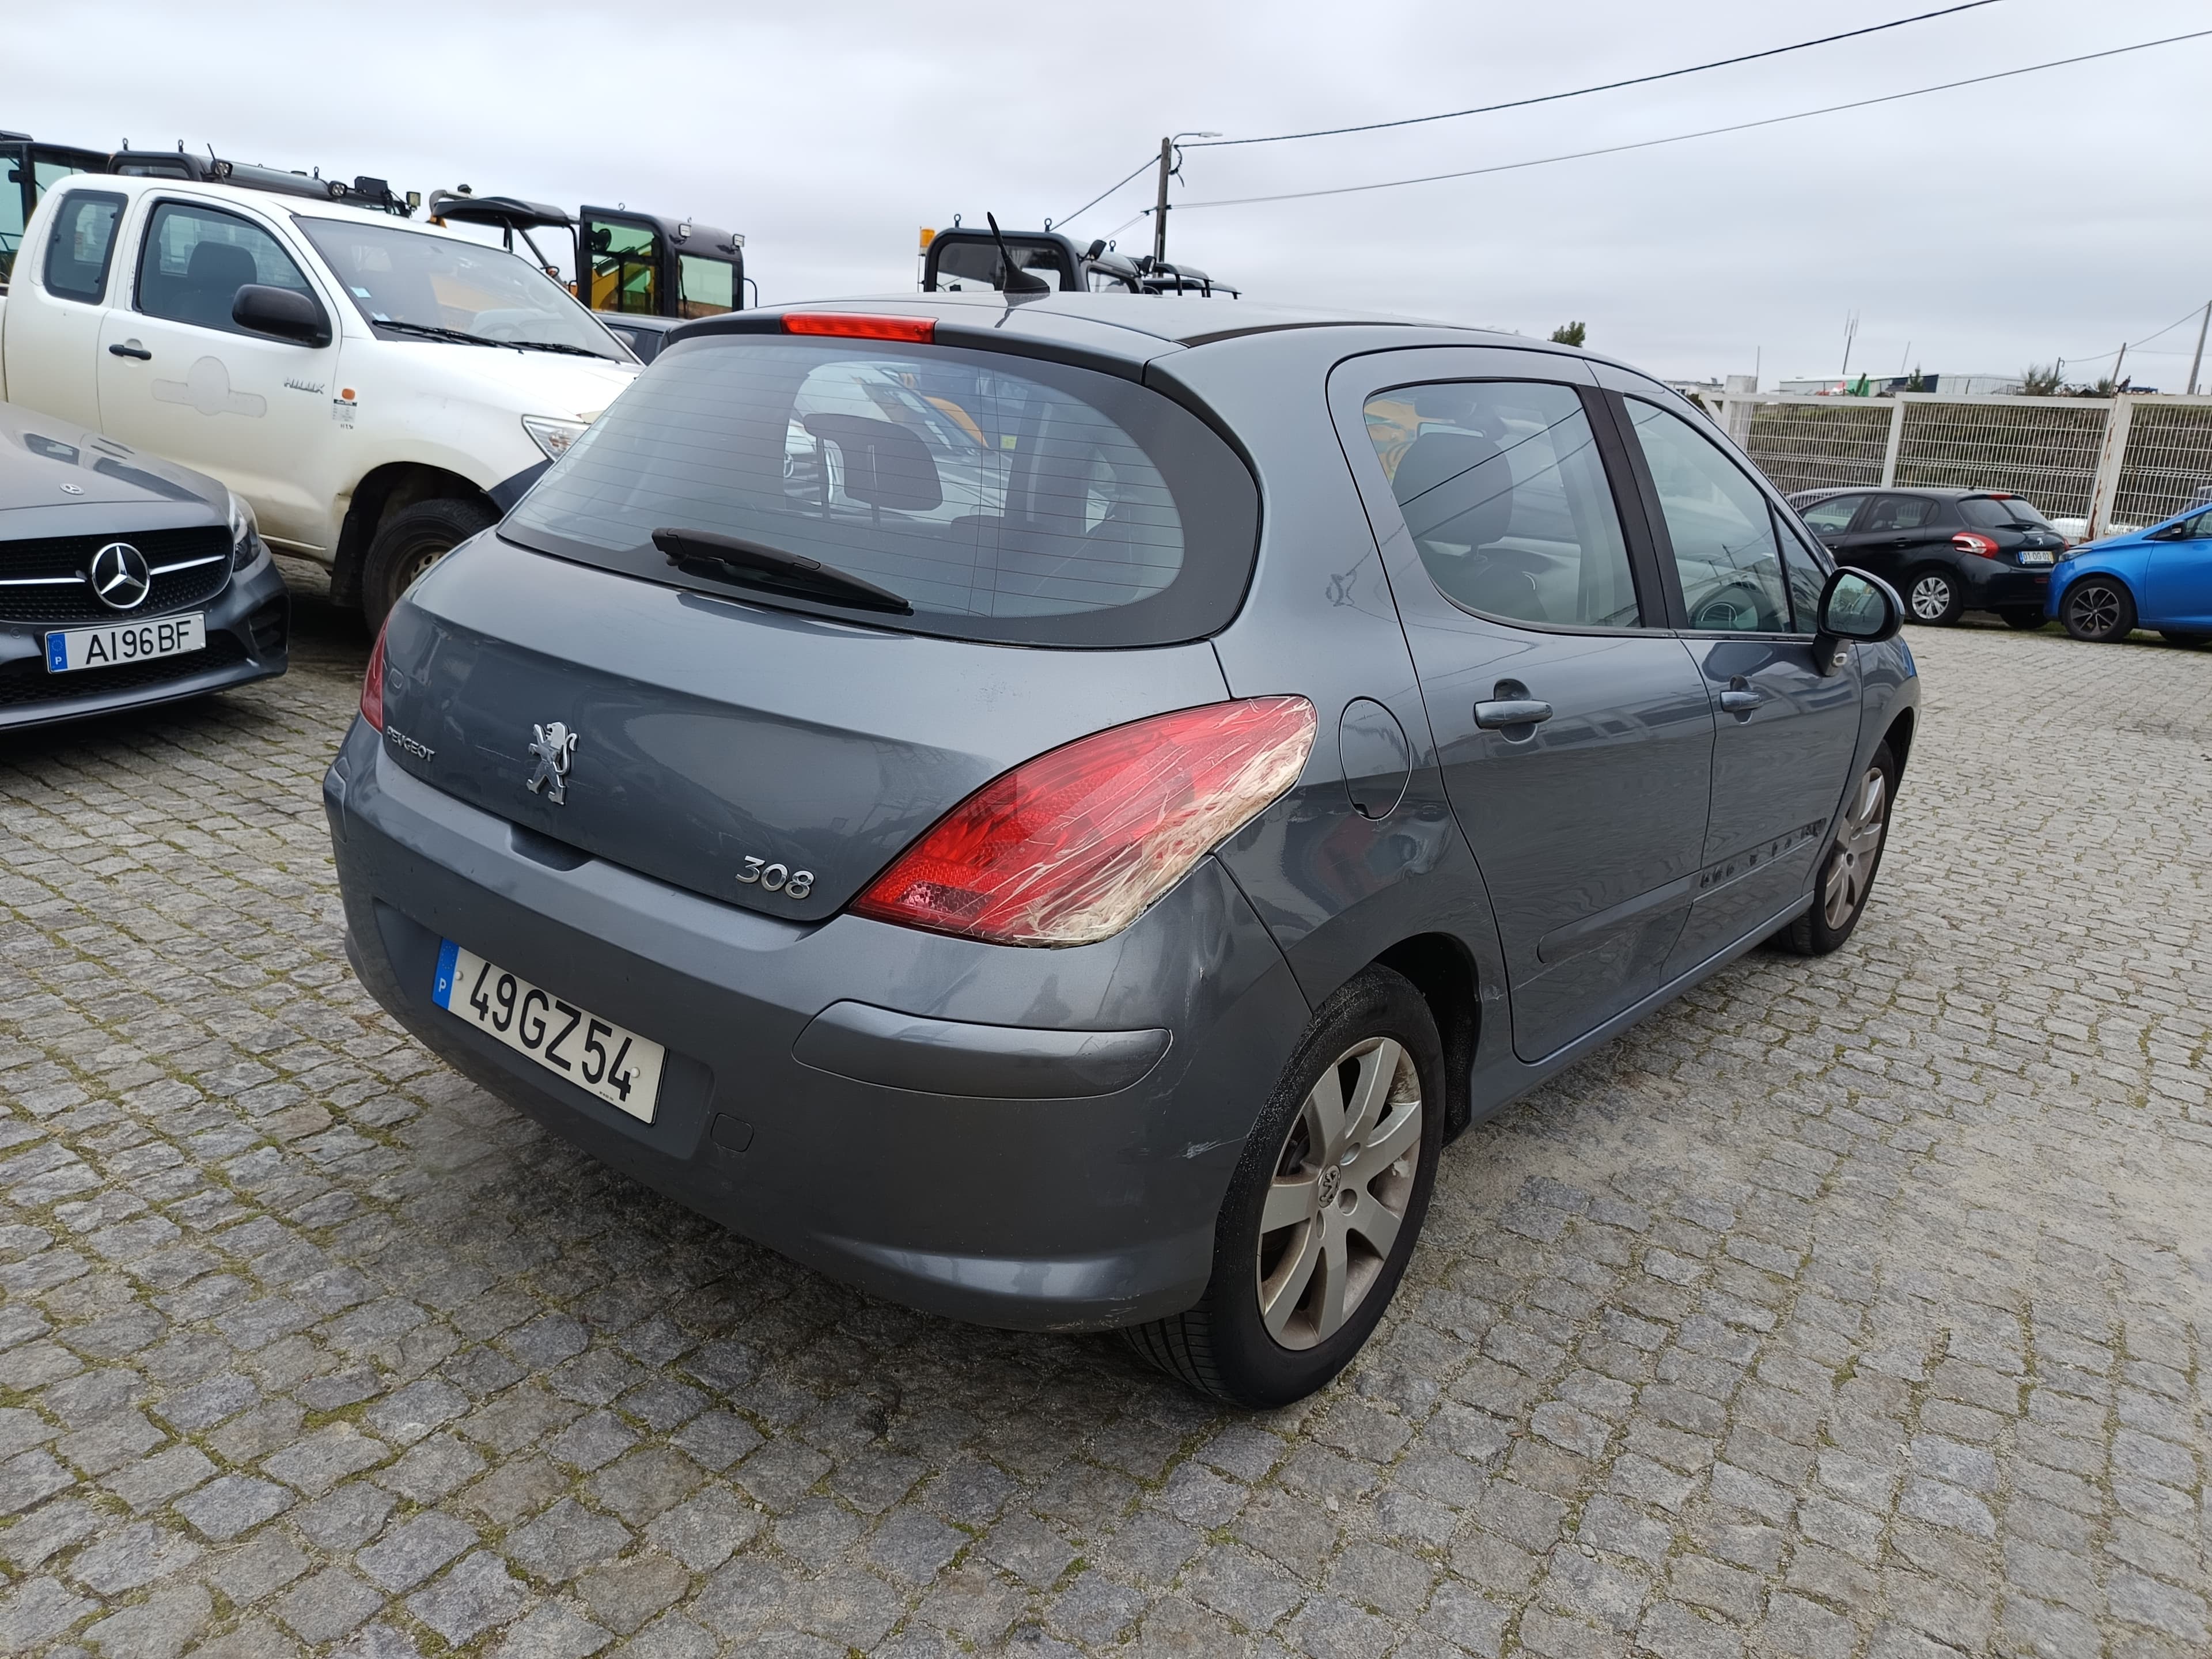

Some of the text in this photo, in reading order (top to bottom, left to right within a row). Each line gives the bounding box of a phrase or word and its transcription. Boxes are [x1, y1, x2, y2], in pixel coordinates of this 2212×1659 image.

[55, 657, 62, 665] P
[387, 725, 435, 762] PEUGEOT
[735, 855, 815, 899] 308
[438, 978, 446, 992] P
[469, 962, 633, 1102] 49GZ54
